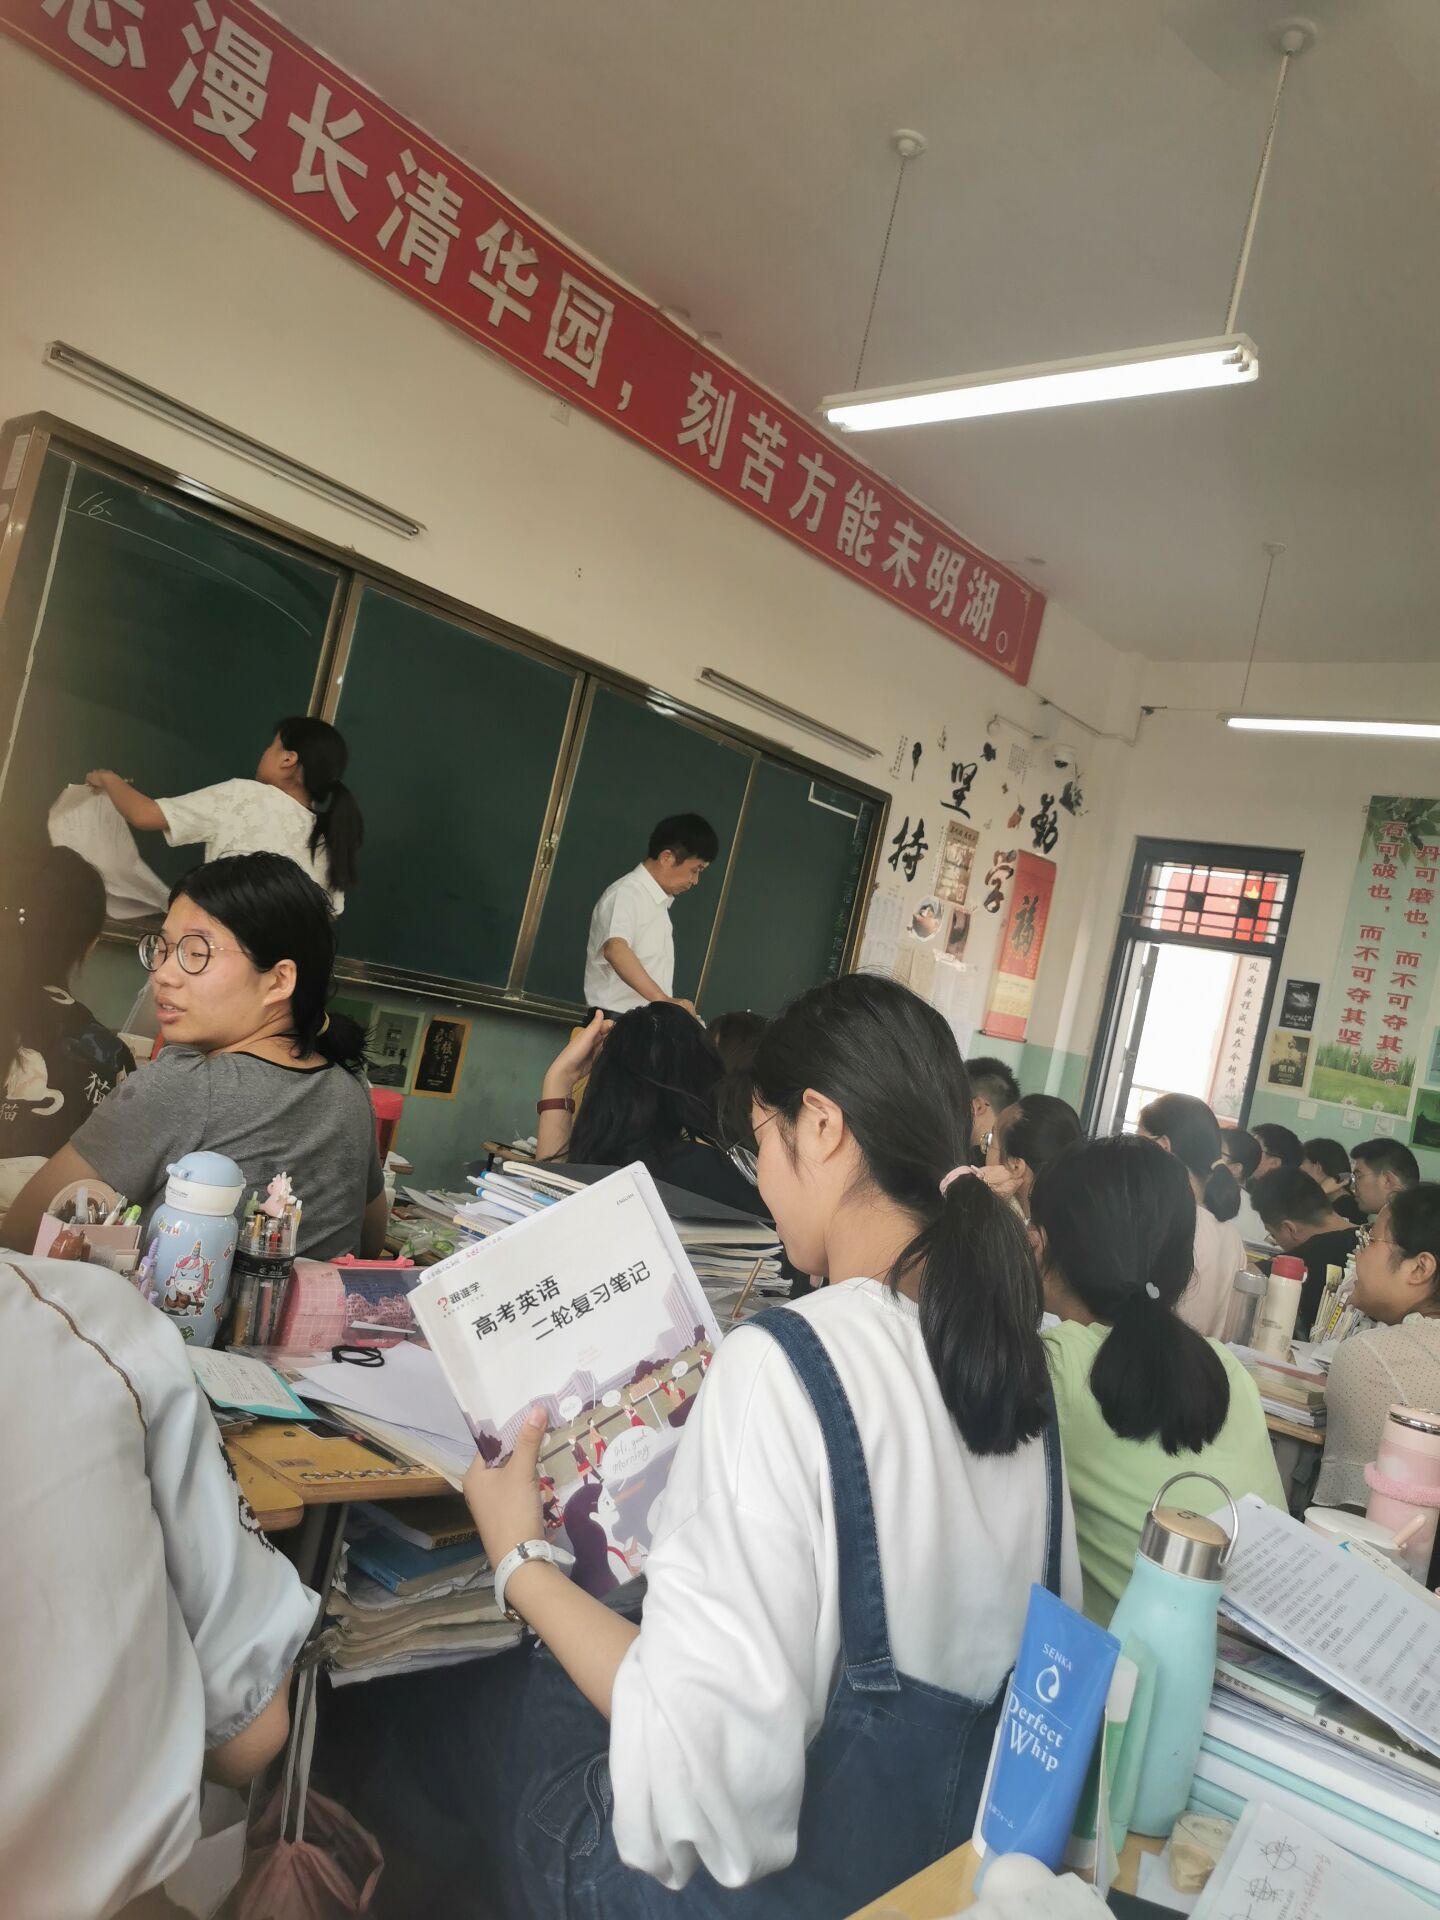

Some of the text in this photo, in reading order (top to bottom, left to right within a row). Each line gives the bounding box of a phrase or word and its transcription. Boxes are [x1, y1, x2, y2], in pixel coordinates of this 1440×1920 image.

[449, 1282, 480, 1304] 跟谁学
[472, 1275, 560, 1340] 高考英语
[531, 1260, 650, 1341] 二轮复习笔记
[1042, 1643, 1073, 1672] SENKA
[1005, 1692, 1065, 1748] Perfect
[1009, 1718, 1059, 1772] Whip
